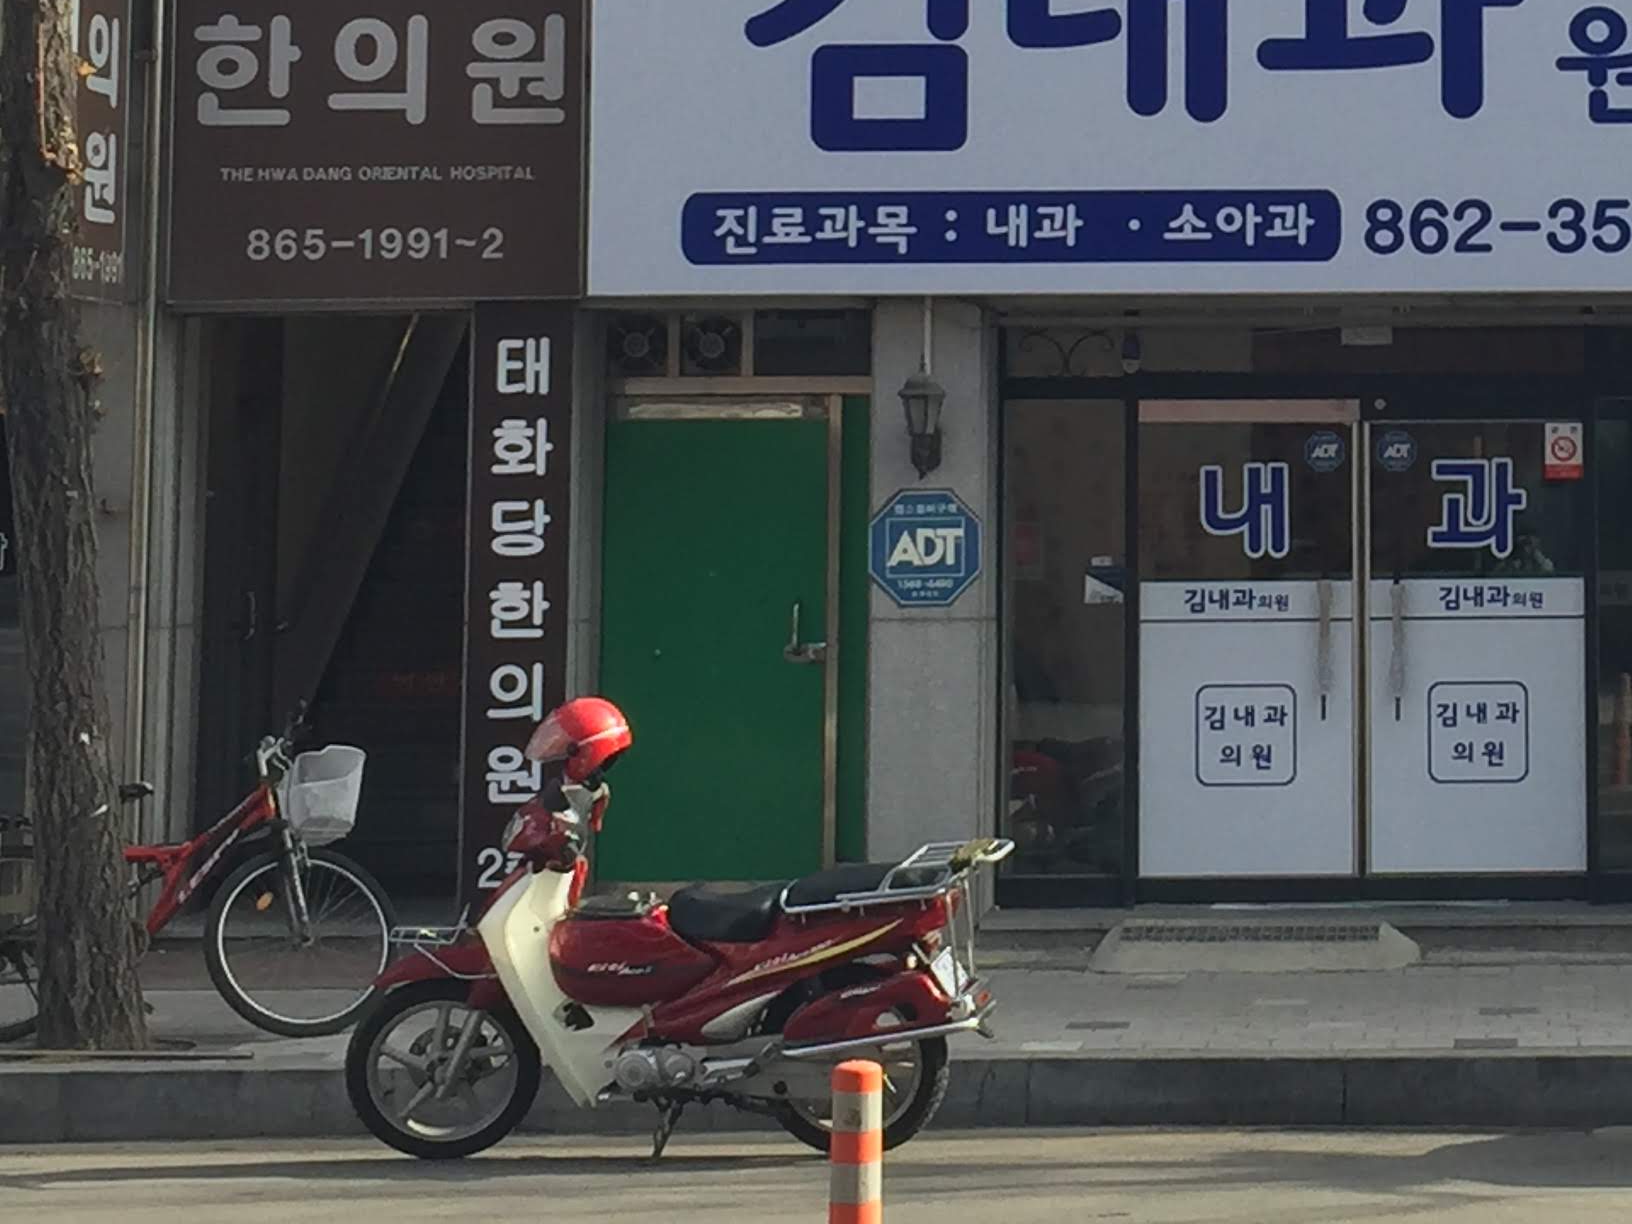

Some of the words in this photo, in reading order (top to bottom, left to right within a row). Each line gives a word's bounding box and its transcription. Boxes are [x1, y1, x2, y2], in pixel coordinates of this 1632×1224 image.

[194, 14, 566, 126] 한의원
[258, 167, 299, 182] HWA
[303, 167, 352, 181] DANG
[359, 167, 442, 181] ORIENTAL
[450, 166, 534, 180] HOSPITAL
[714, 205, 918, 255] 진료과목
[986, 204, 1084, 248] 내과
[1163, 203, 1315, 248] 소아과
[247, 227, 504, 261] 865-1991~2
[886, 527, 964, 567] ADT
[485, 336, 552, 803] 태화당한의원
[1184, 588, 1290, 613] 김내과의원
[1439, 585, 1544, 610] 김내과의원
[1204, 705, 1288, 730] 김내과
[1436, 702, 1520, 727] 김내과
[1219, 744, 1273, 770] 의원
[1451, 741, 1505, 767] 의원
